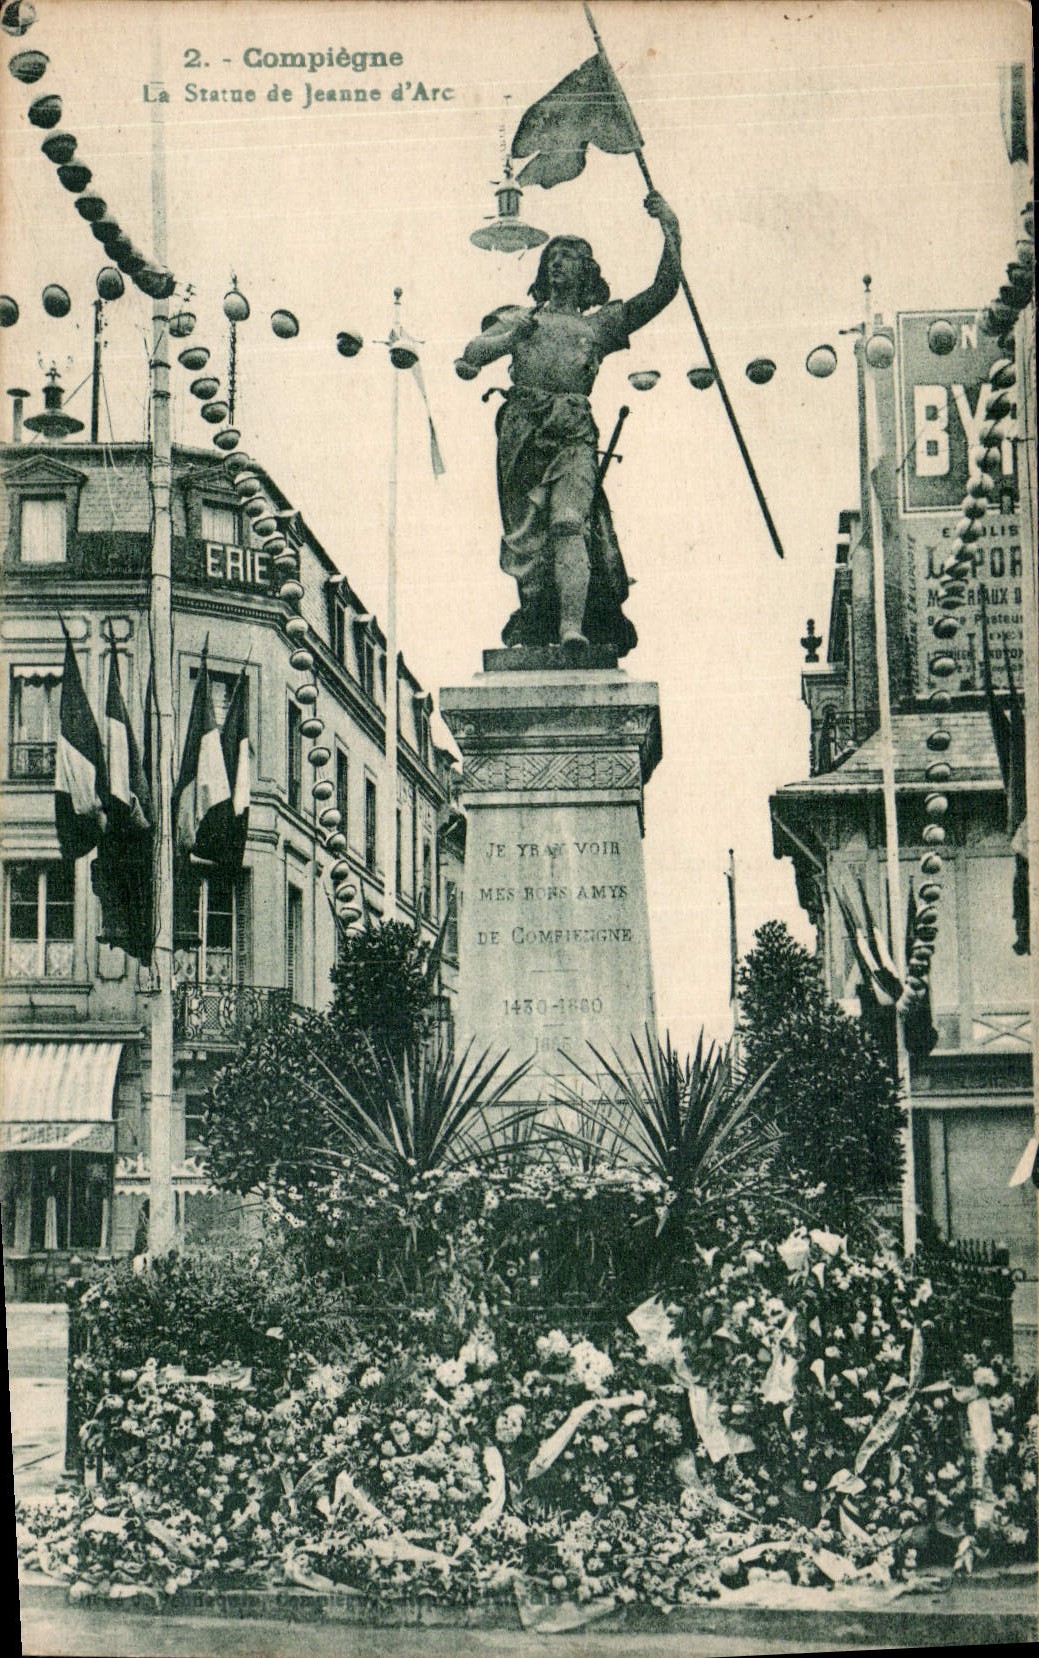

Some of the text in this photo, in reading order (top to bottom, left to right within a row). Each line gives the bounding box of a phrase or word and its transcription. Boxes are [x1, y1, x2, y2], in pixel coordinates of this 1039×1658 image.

[206, 543, 271, 586] ERIE
[575, 841, 621, 856] VOIR
[479, 885, 627, 901] MES BONS AMYS
[477, 931, 500, 945] DE
